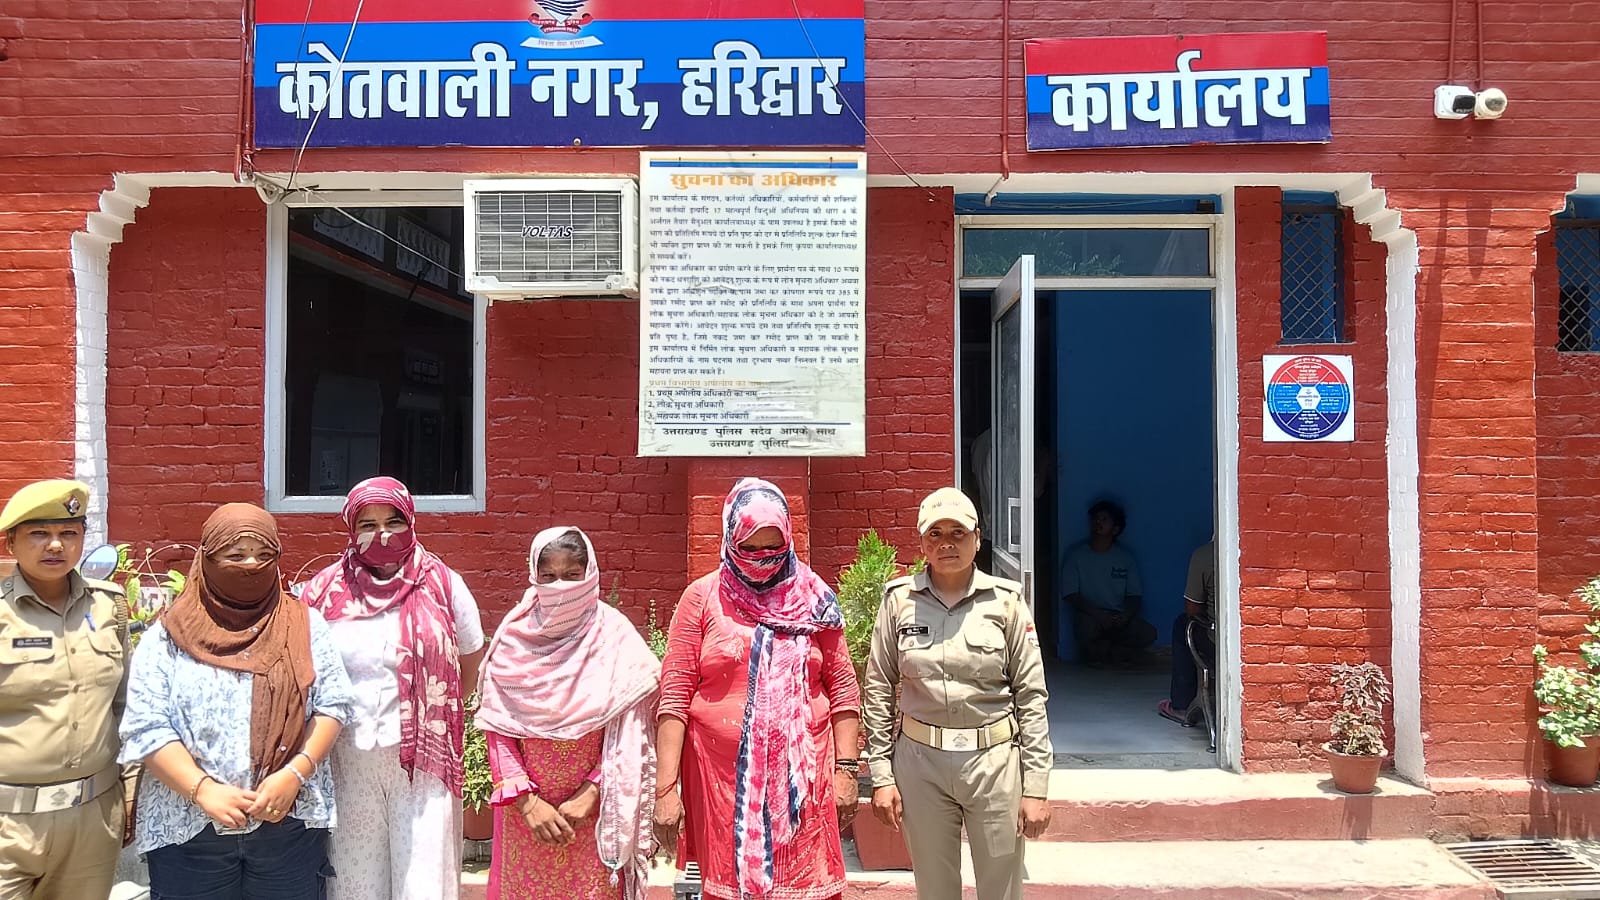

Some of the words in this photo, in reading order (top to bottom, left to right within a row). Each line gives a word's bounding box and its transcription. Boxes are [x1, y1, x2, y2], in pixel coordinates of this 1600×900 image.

[275, 43, 516, 119] कोतवाली
[528, 59, 659, 130] नगर,
[679, 40, 846, 117] हरिद्वार
[1047, 50, 1311, 131] कार्यालय
[728, 173, 754, 187] का
[761, 171, 839, 187] अधिकार
[521, 226, 573, 237] VOLTAS
[649, 389, 654, 398] 1.
[648, 398, 654, 409] 2.
[662, 427, 708, 436] उत्तराखण्ड
[715, 425, 742, 438] पुलिस
[750, 425, 771, 436] सदैव
[781, 426, 808, 436] आपके
[816, 427, 836, 437] साथ
[709, 439, 755, 448] उत्तराखण्ड
[761, 436, 789, 450] पुलिस
